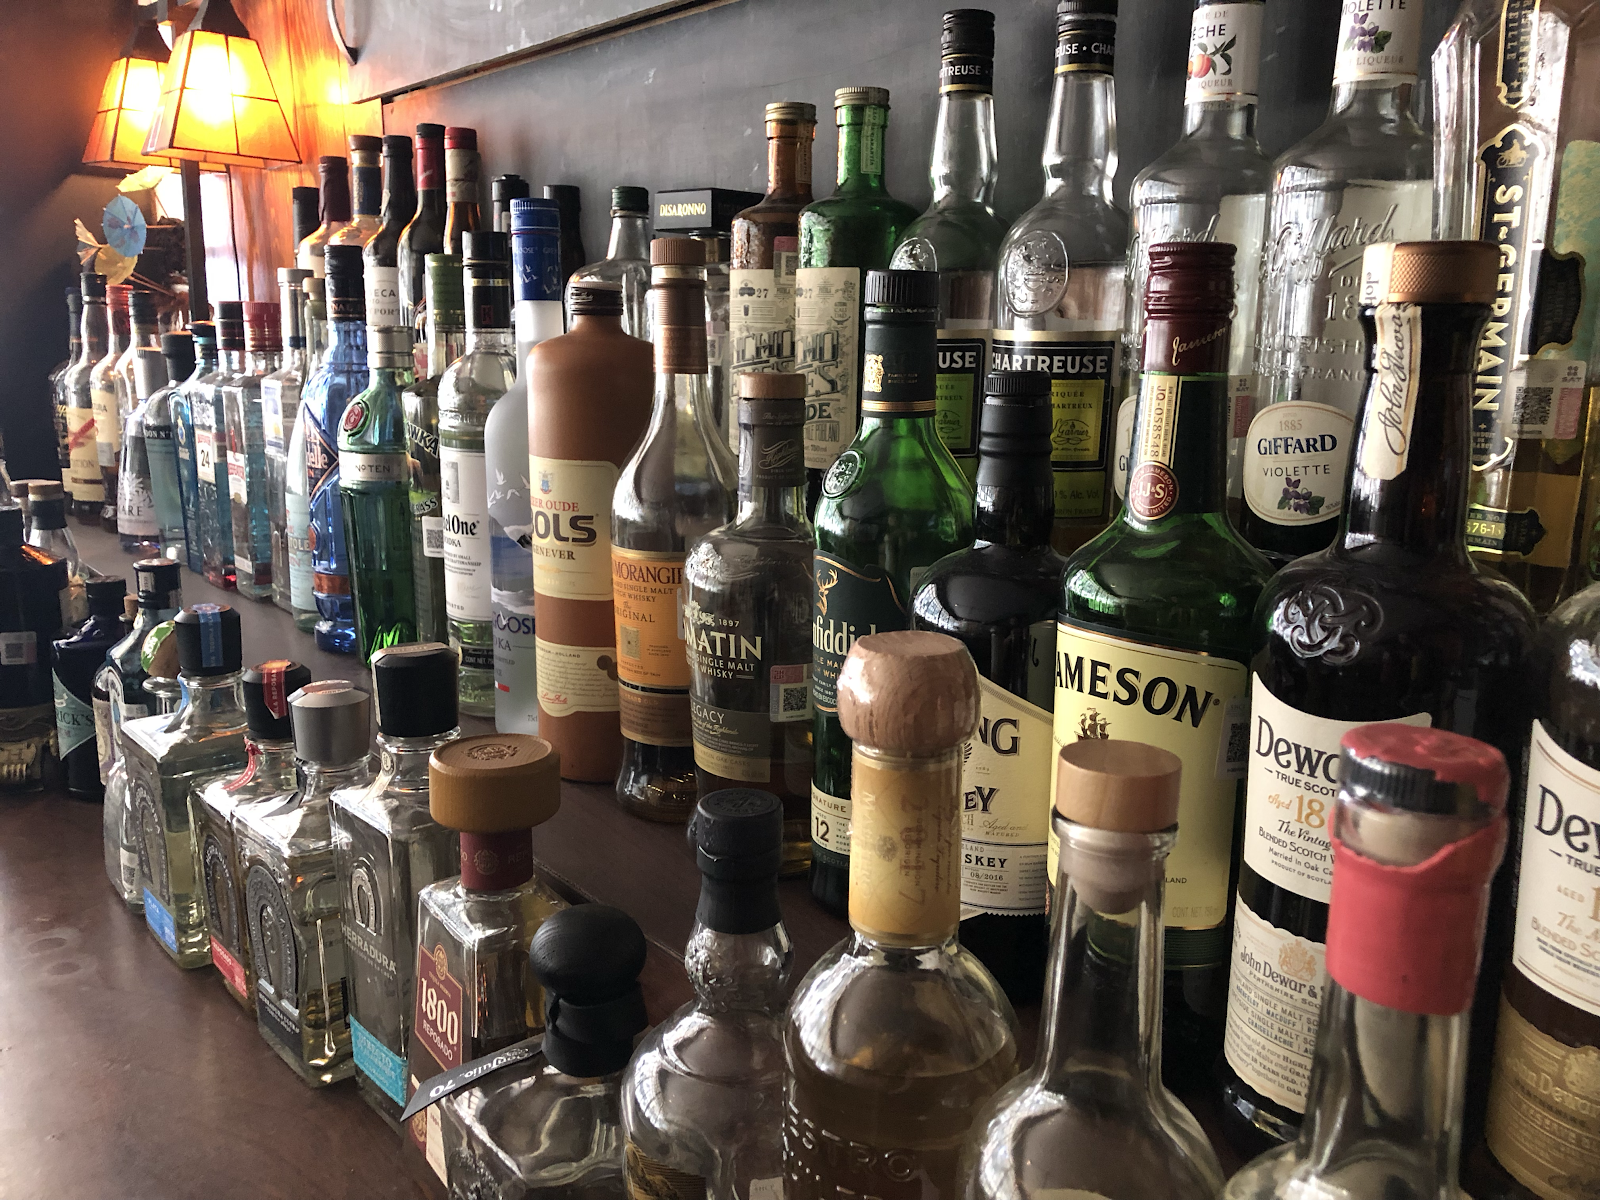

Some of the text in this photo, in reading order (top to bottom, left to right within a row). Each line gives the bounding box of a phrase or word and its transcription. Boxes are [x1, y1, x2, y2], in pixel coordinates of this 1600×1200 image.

[659, 202, 707, 218] DISARONNO
[756, 288, 769, 298] 27
[804, 288, 813, 298] 27
[992, 351, 1110, 374] CHARTREUSE
[1278, 418, 1303, 432] 1885
[200, 449, 210, 468] 24
[369, 464, 391, 473] TEN
[1262, 463, 1331, 478] VIOLETTE
[545, 501, 580, 512] OUDE
[451, 514, 477, 536] One
[624, 583, 674, 595] SINGLE MALT
[628, 592, 656, 603] WHISKY
[719, 618, 740, 628] 1897
[700, 665, 734, 680] WHISKY
[727, 660, 755, 672] MALT
[1275, 770, 1302, 788] TRUE
[1268, 794, 1326, 830] Aged 18
[815, 816, 830, 843] 12
[1278, 819, 1296, 837] The
[1258, 826, 1327, 863] BLENDED SCOTCH
[964, 853, 1008, 869] SKEY
[1269, 846, 1293, 864] Married
[1304, 858, 1320, 872] Oak
[969, 870, 1004, 881] 08/2016
[1271, 859, 1296, 873] PRODUCT
[1297, 869, 1306, 878] OF
[1557, 884, 1585, 903] AGED
[1557, 911, 1582, 935] The
[1240, 945, 1318, 1000] John Dewar &
[421, 977, 459, 1045] 1800
[1266, 1008, 1297, 1028] MACDUFF
[1281, 1006, 1304, 1022] MALT
[423, 1019, 453, 1061] REPOSADO
[1278, 1026, 1300, 1041] MALT
[430, 1079, 456, 1098] 70
